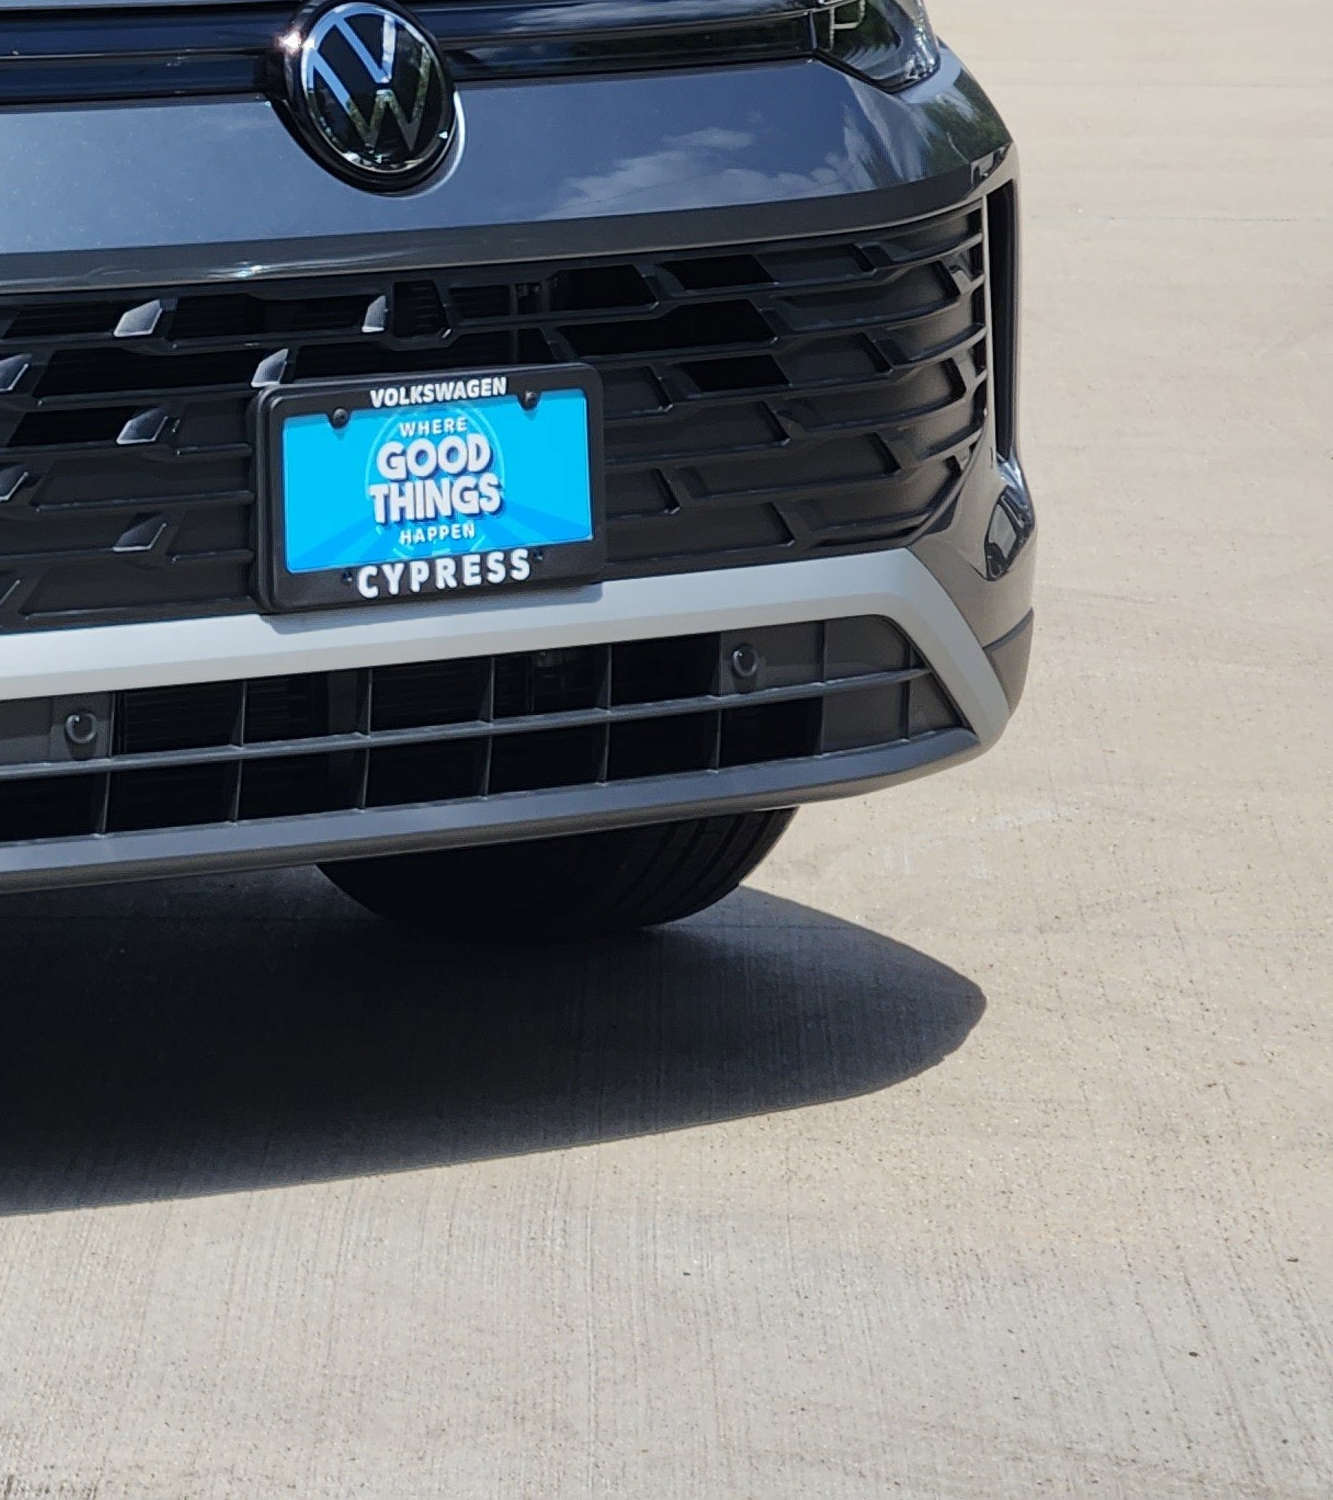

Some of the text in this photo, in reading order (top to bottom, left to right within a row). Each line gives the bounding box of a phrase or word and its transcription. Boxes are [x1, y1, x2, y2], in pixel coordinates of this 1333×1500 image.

[370, 376, 508, 408] VOLKSWAGEN
[399, 417, 468, 438] WHERE
[377, 433, 491, 480] GOOD
[368, 472, 501, 524] THINGS
[399, 521, 476, 545] HAPPEN
[357, 548, 531, 599] CYPRESS
